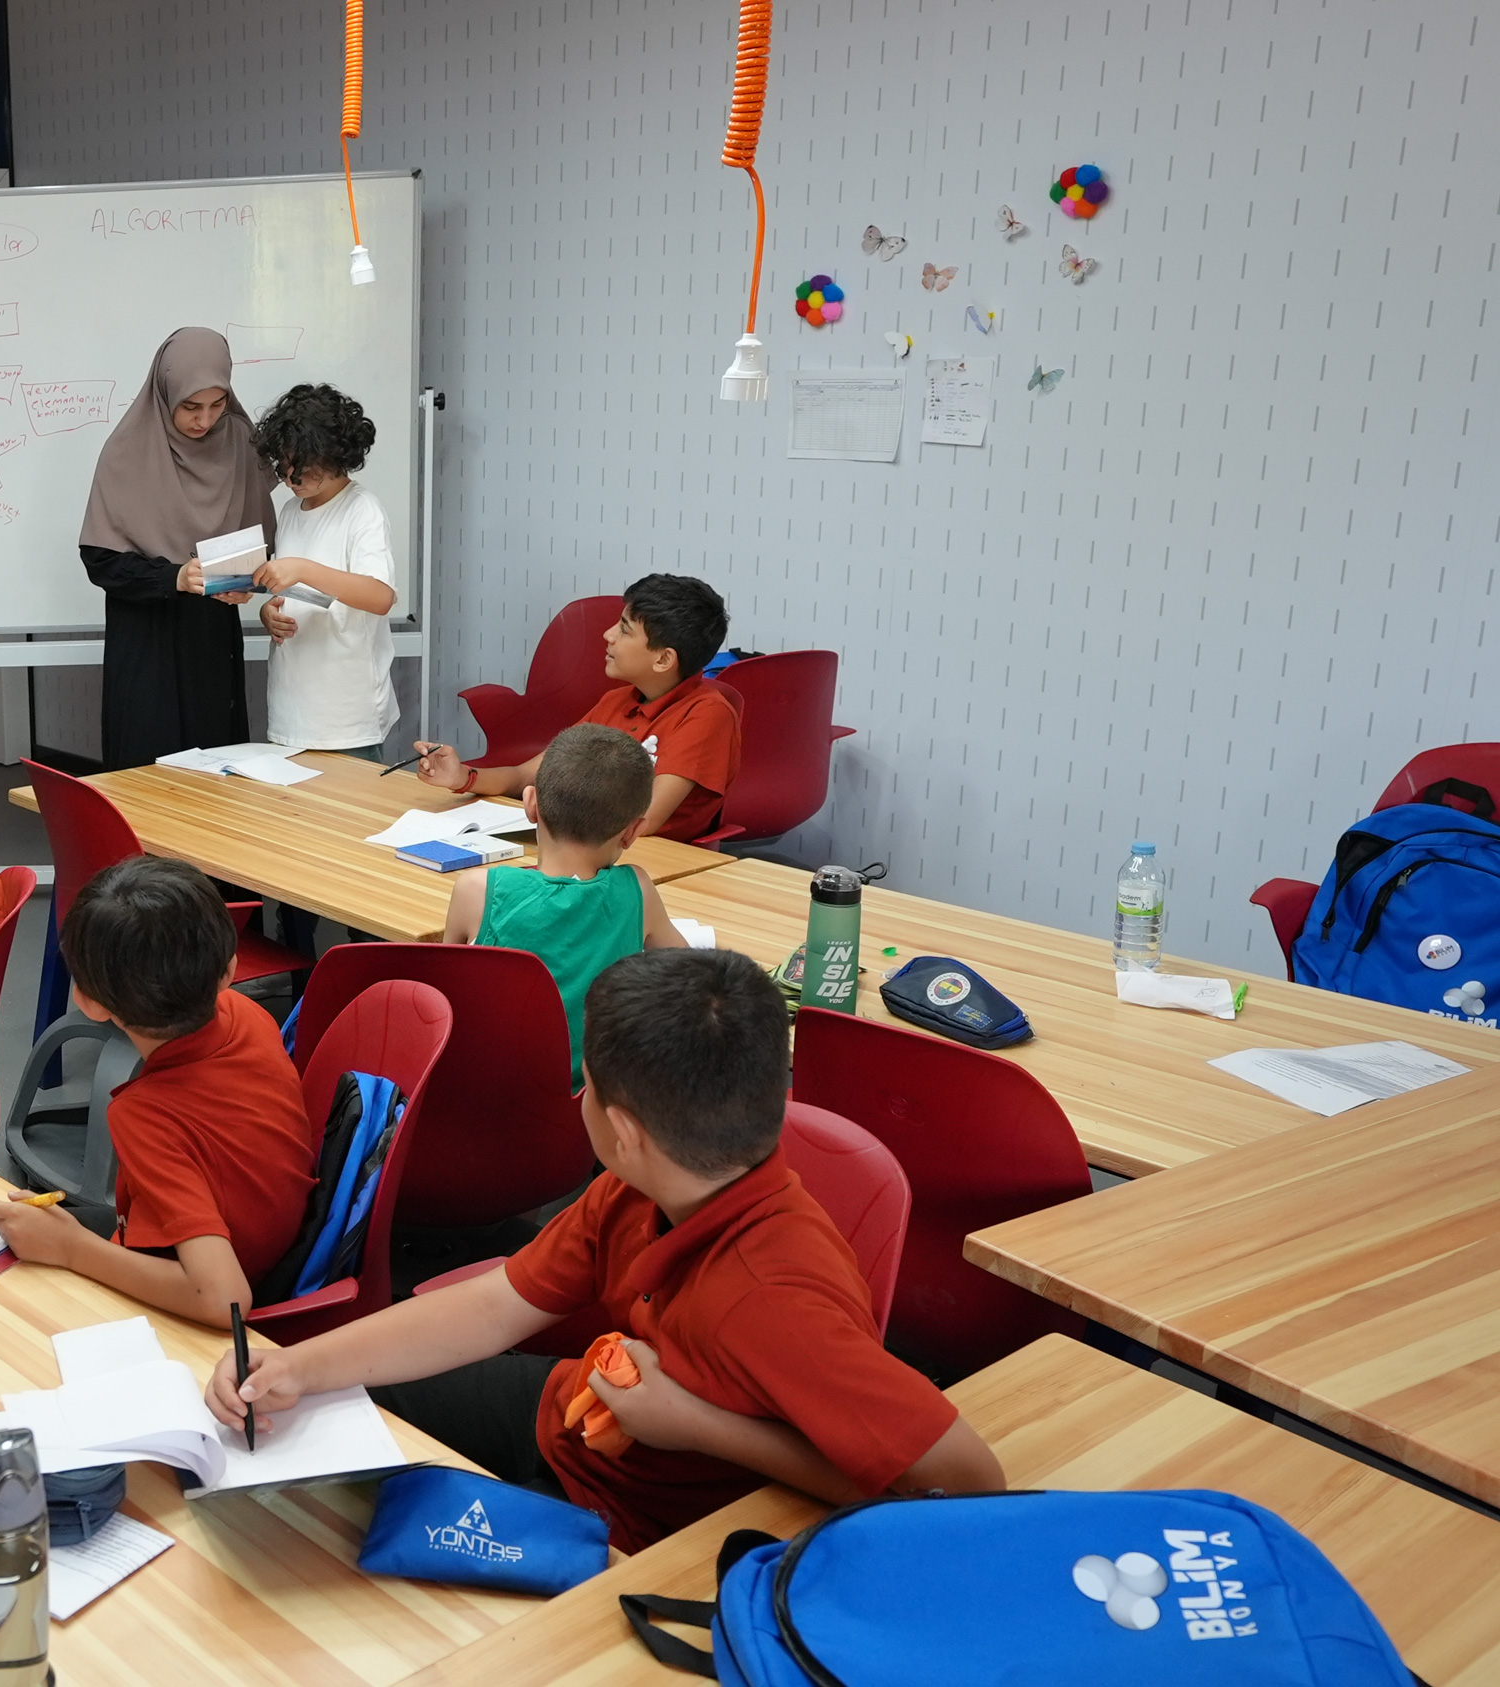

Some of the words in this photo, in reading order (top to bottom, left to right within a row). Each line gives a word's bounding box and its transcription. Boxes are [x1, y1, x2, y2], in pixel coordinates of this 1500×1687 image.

[822, 946, 853, 962] IN
[822, 964, 852, 980] SI
[816, 981, 854, 998] DE
[425, 1525, 523, 1562] YÖNTAŞ
[1162, 1529, 1235, 1641] BİLİM
[1208, 1530, 1259, 1637] KONYA
